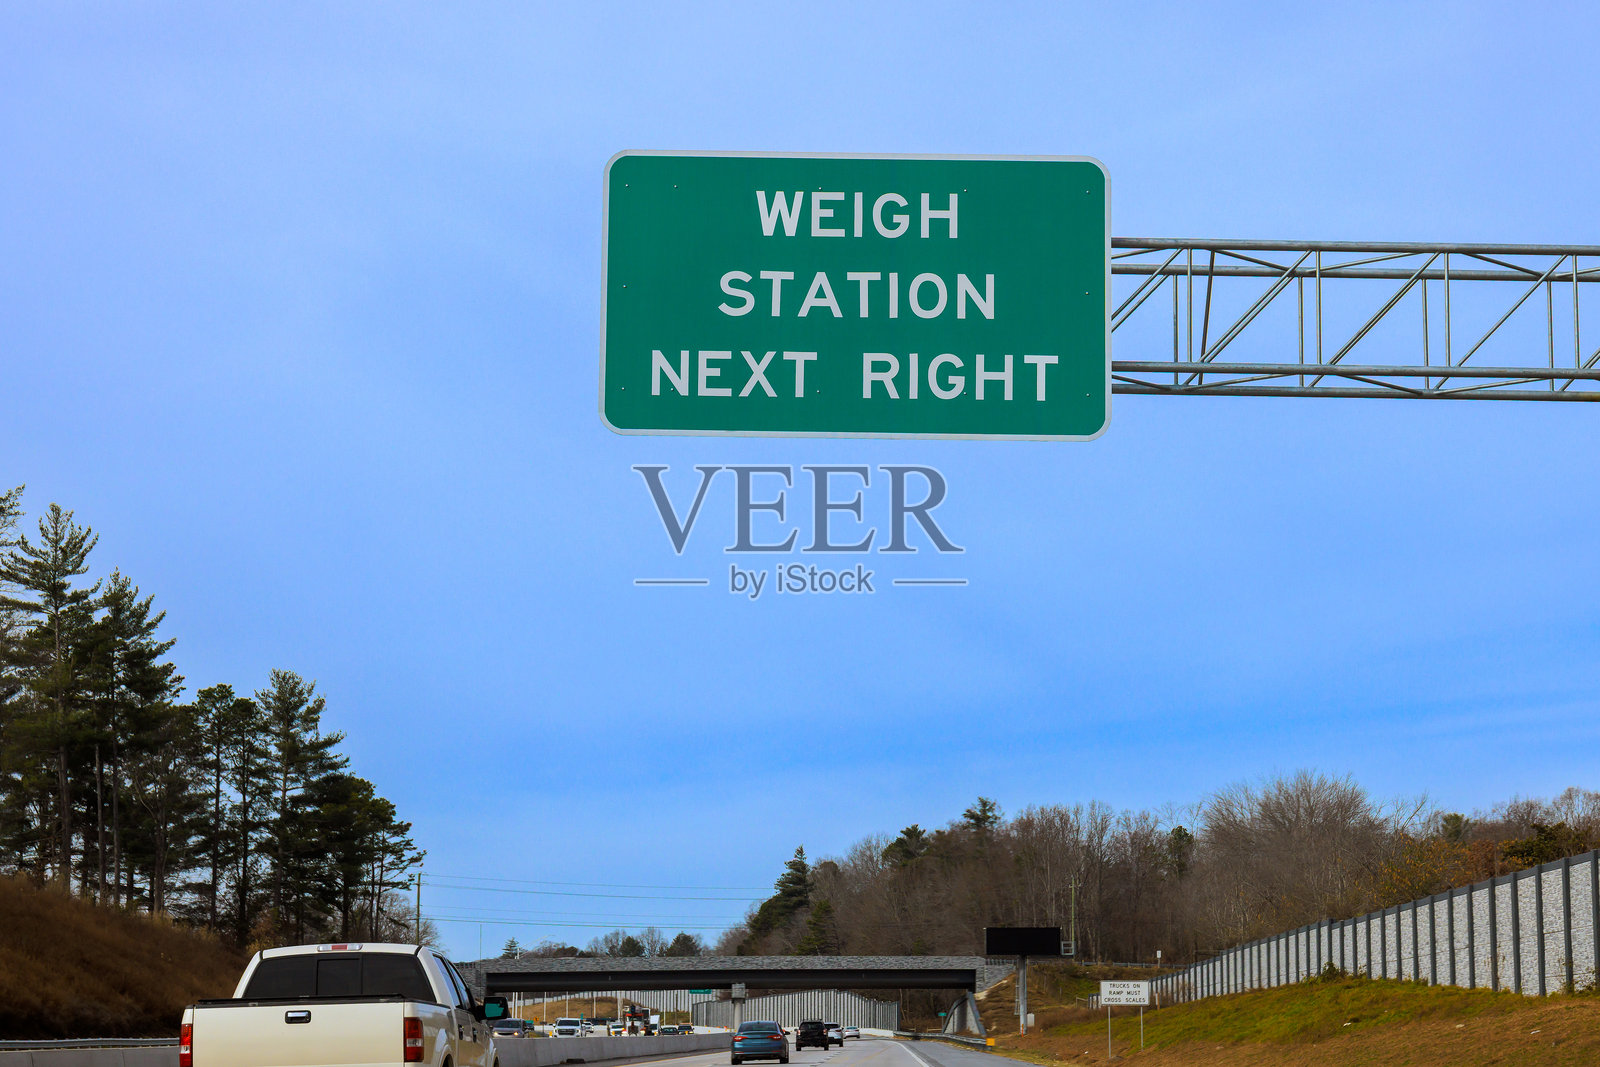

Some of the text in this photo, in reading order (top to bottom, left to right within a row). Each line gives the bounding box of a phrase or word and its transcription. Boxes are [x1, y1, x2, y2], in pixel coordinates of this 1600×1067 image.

[755, 190, 959, 240] WEIGH
[718, 270, 995, 320] STATION
[651, 349, 1060, 402] NEXT RIGHT
